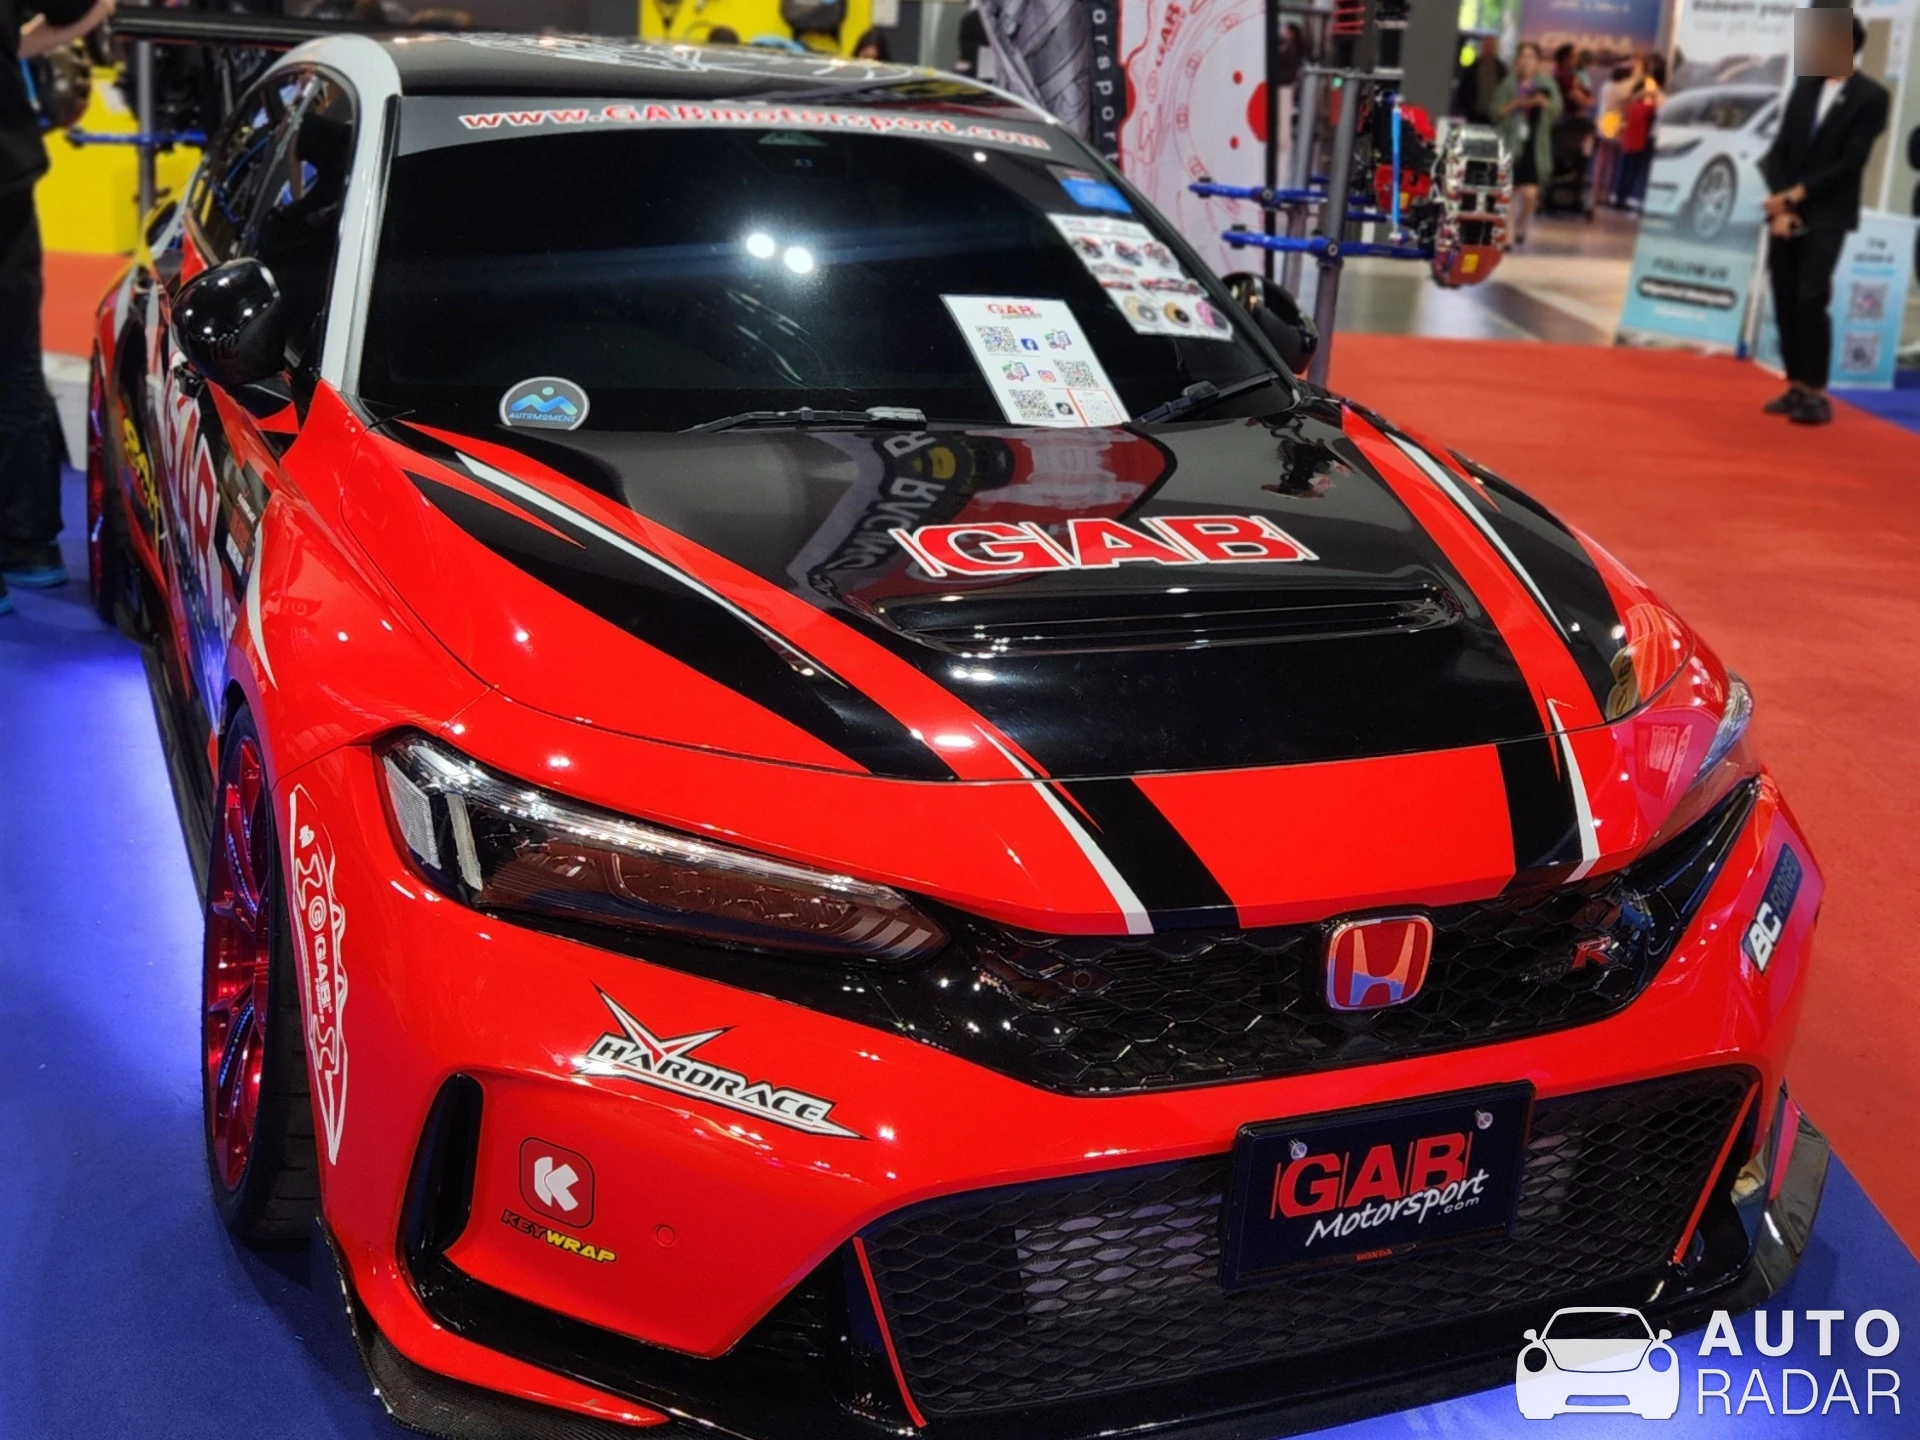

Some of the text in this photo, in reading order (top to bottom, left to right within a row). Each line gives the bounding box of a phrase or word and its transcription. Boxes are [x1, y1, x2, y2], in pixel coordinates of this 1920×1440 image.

[459, 104, 1052, 150] www.GABmotorsport.com
[905, 515, 1312, 577] GAB
[1748, 902, 1782, 972] BC
[596, 1040, 828, 1124] HARDRACE
[1275, 1131, 1470, 1219] GAB
[1305, 1169, 1489, 1247] Motorsport
[500, 1208, 618, 1264] KEYWRAP
[1356, 1248, 1394, 1261] HONDA
